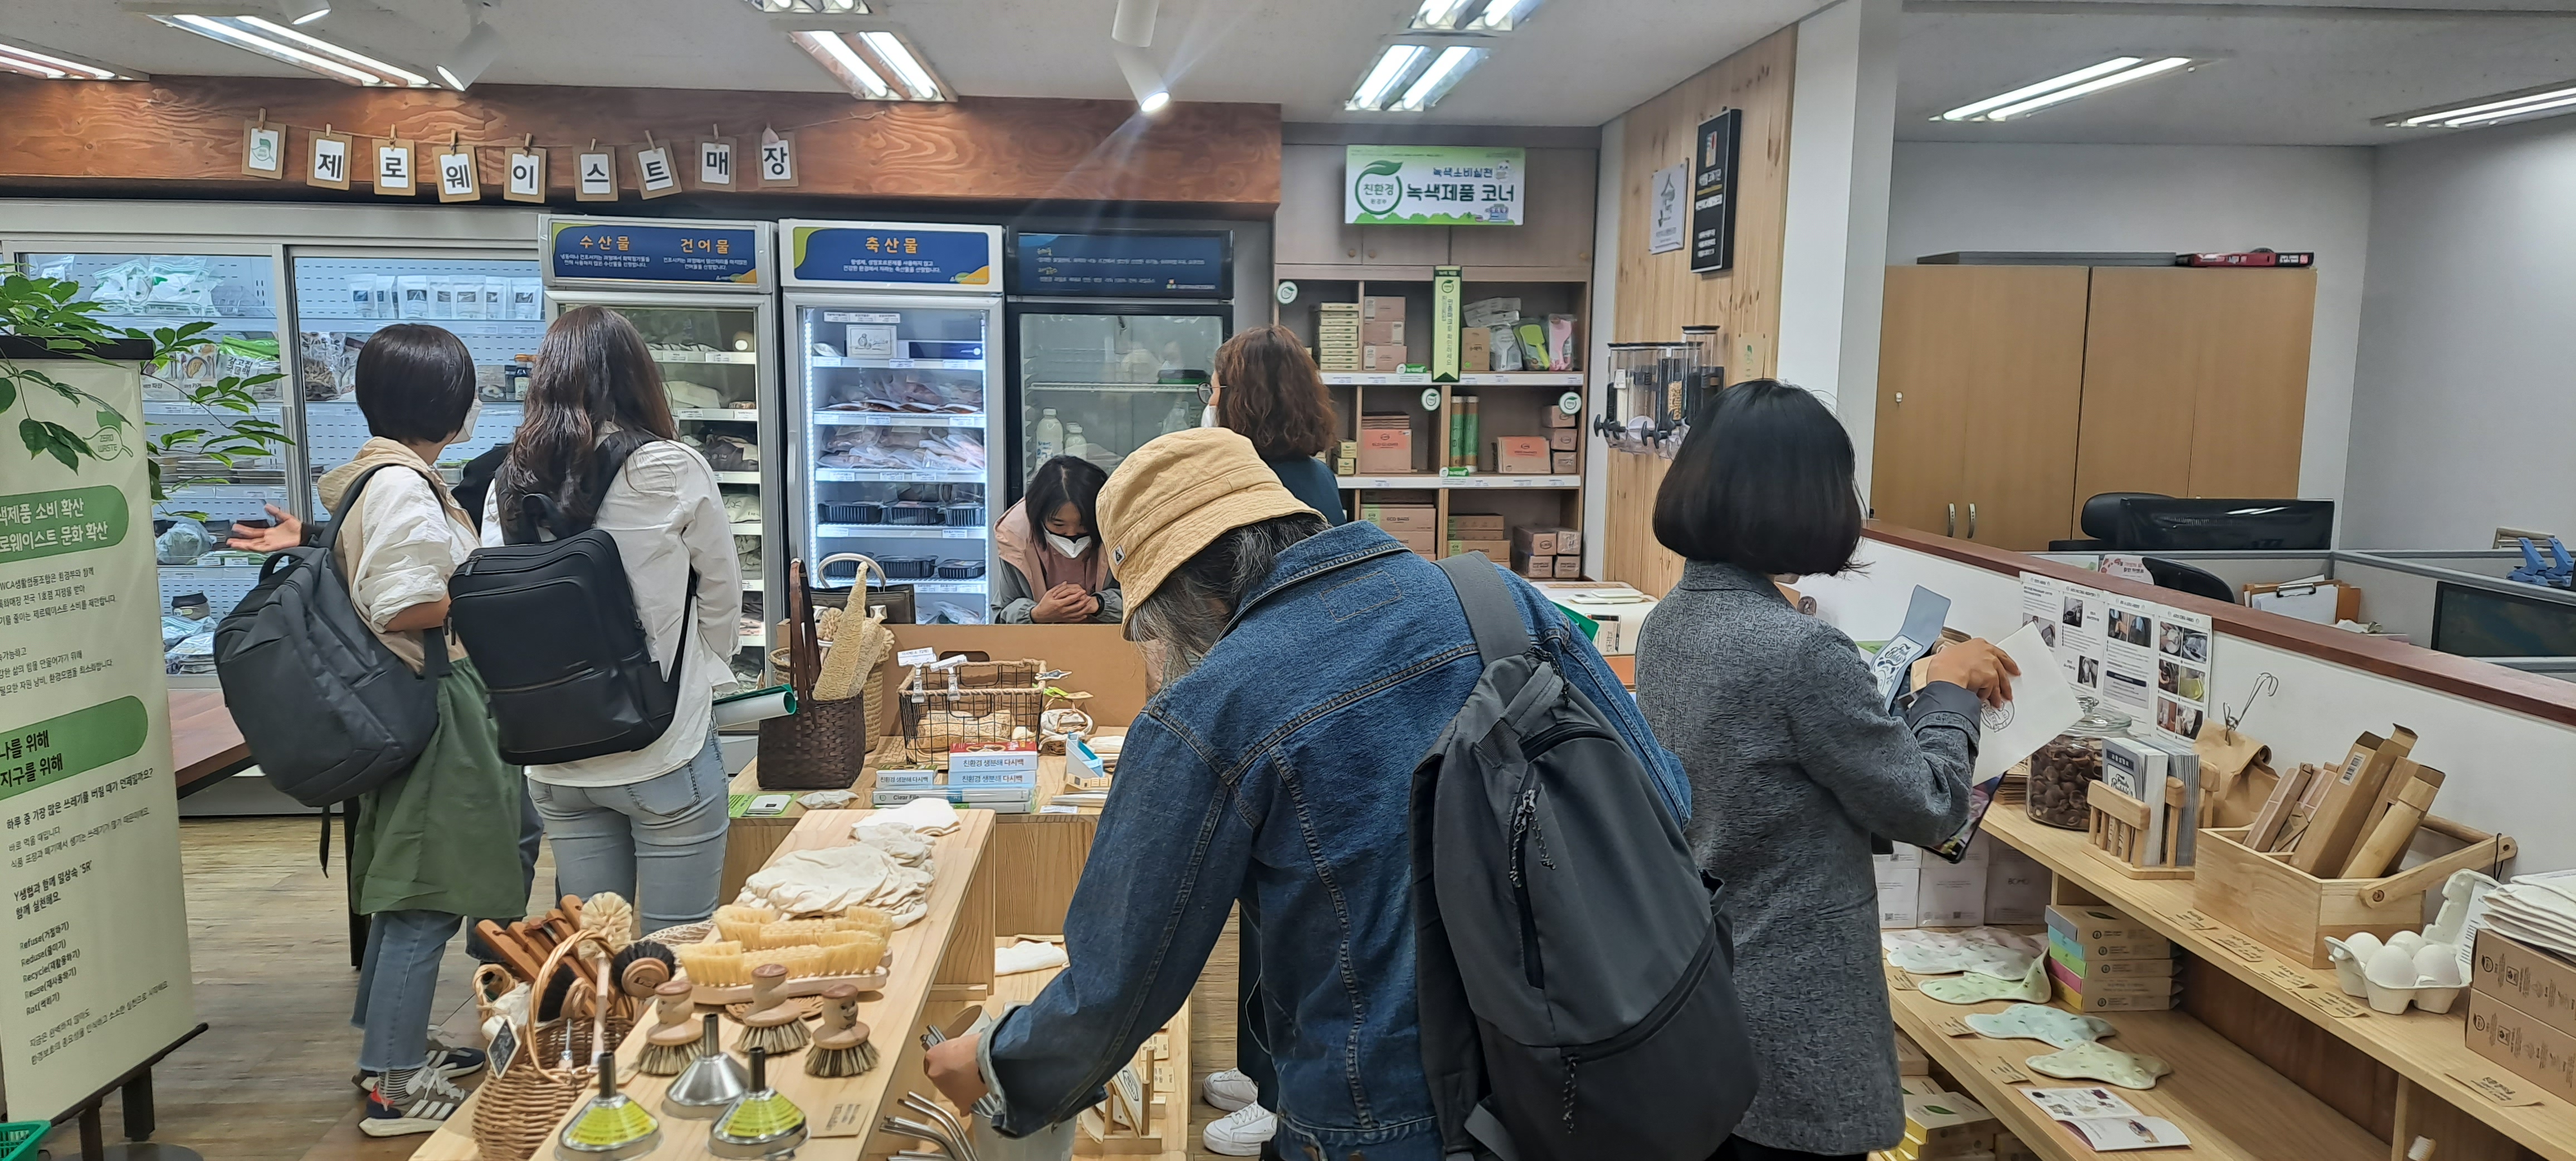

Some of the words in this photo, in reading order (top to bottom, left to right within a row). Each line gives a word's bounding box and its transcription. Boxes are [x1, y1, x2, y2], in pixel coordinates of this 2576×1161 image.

[1364, 183, 1394, 196] 친환경
[1407, 183, 1475, 202] 녹색제품
[1481, 184, 1515, 202] 코너
[579, 235, 630, 251] 수산물
[680, 238, 730, 254] 건어물
[865, 237, 918, 253] 축산물
[100, 434, 114, 442] ZERO
[98, 443, 118, 452] WASTE
[35, 500, 59, 520] 소비
[61, 497, 85, 519] 확산
[0, 529, 58, 553] 로웨이스트
[60, 524, 84, 547] 문화
[85, 520, 108, 542] 확산
[26, 729, 50, 753] 위해
[0, 762, 37, 788] 지구를
[40, 753, 64, 777] 위해
[963, 758, 983, 767] 친환경
[983, 758, 1003, 767] 생분해
[1004, 758, 1024, 767] 다시백
[962, 775, 981, 784] 친환경
[982, 775, 1002, 784] 생분해
[1003, 775, 1023, 784] 다시백
[6, 816, 22, 830] 하루
[23, 812, 31, 826] 중
[32, 807, 46, 821] 가장
[47, 801, 62, 817] 많은
[63, 791, 89, 809] 쓰레기를
[90, 785, 105, 799] 버릴
[16, 903, 31, 920] 함께
